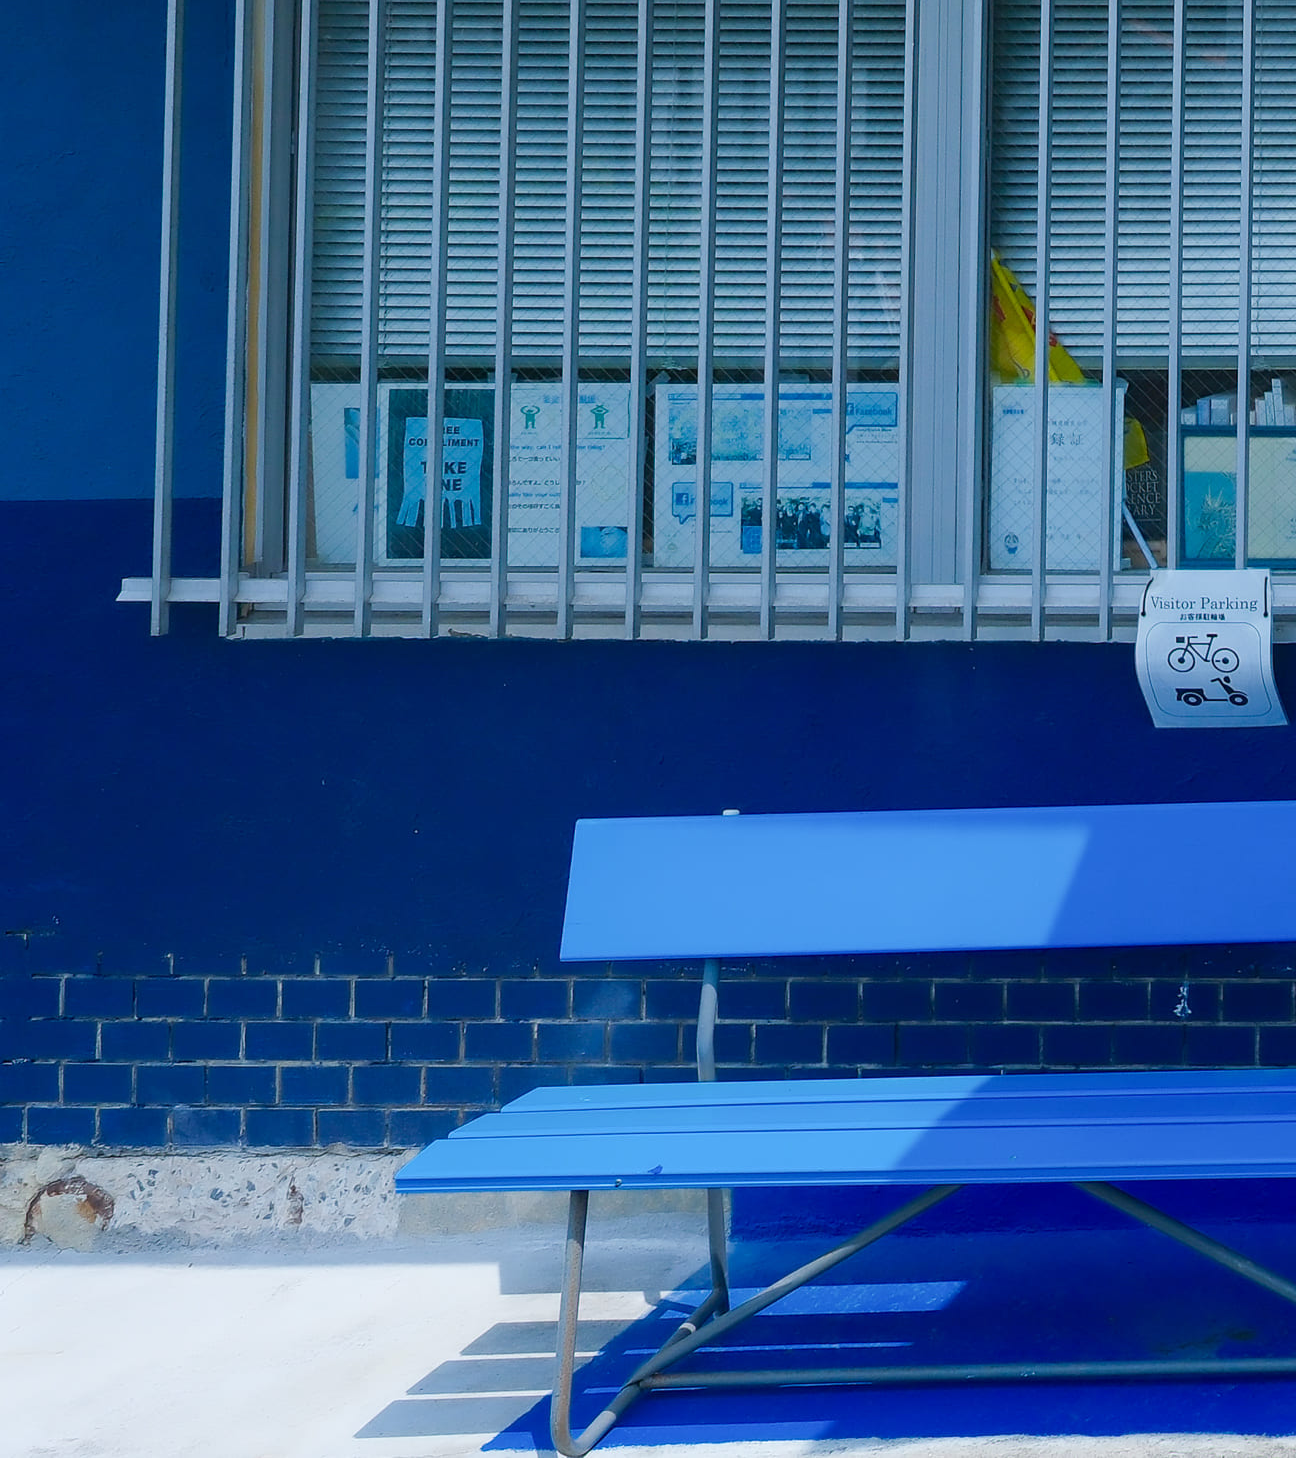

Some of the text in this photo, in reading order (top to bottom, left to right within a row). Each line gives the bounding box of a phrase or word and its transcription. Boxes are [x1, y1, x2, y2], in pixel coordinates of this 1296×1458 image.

[408, 438, 481, 447] COLIMENT
[420, 461, 468, 474] TKE
[1150, 596, 1259, 612] Visitor Parking
